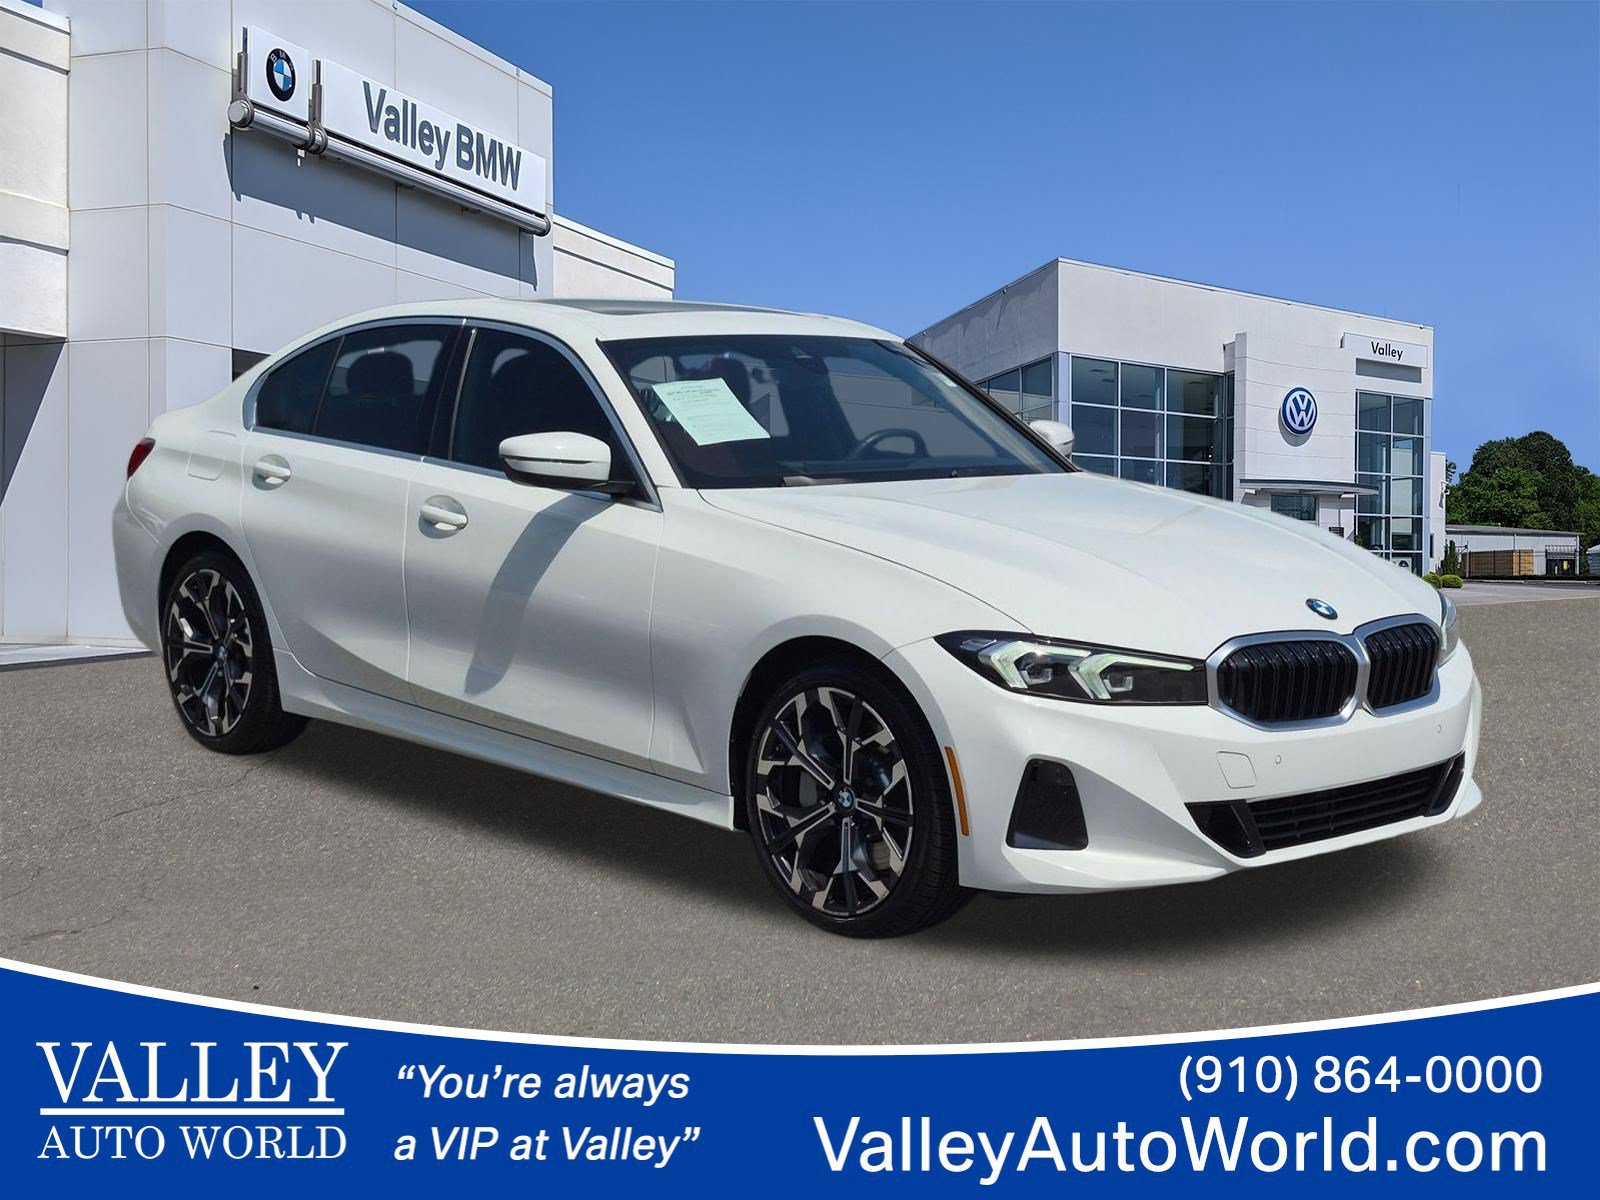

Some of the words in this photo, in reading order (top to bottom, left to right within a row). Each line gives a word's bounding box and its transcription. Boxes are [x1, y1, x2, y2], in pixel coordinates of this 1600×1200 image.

[362, 80, 451, 171] Valley
[456, 122, 522, 191] BMW
[1371, 341, 1403, 361] Valley
[1285, 389, 1316, 432] VW
